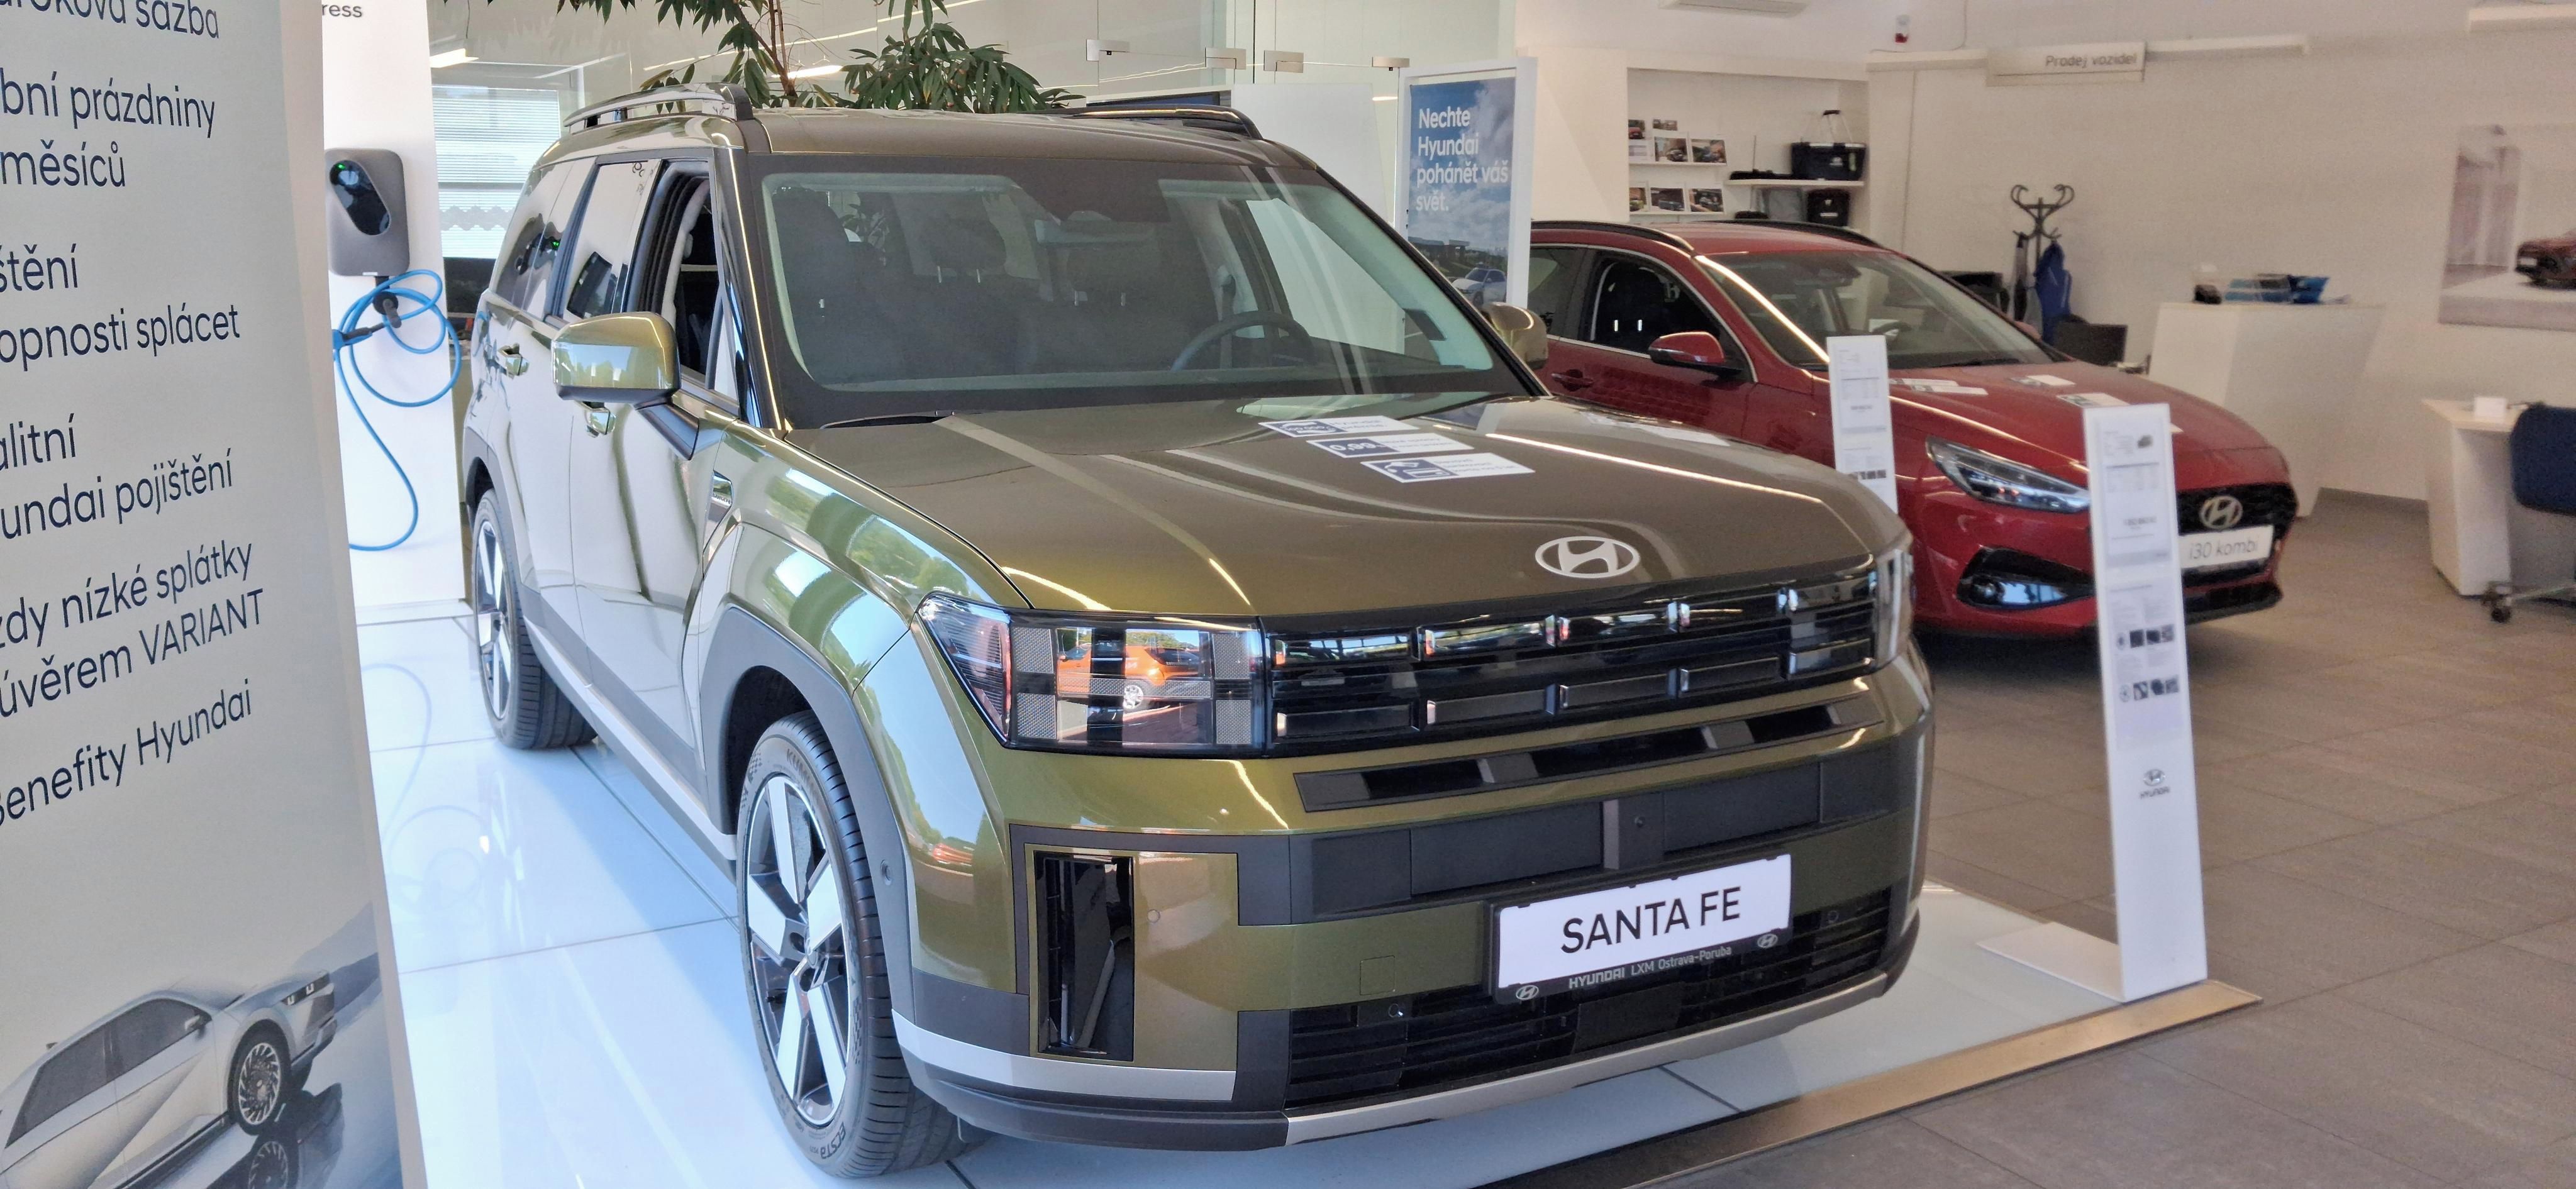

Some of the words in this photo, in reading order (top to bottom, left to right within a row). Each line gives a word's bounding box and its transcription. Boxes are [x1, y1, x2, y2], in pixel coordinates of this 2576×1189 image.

[135, 0, 219, 38] sazba
[2045, 55, 2087, 69] Prodej
[0, 67, 58, 116] bní
[70, 77, 215, 138] prázdniny
[1418, 106, 1471, 129] Nechte
[0, 140, 125, 187] měsíců
[1418, 133, 1479, 160] Hyundai
[1417, 161, 1479, 188] pohánět
[1481, 160, 1509, 184] váš
[1416, 190, 1450, 211] svět.
[0, 308, 128, 372] opnosti
[136, 302, 240, 357] splácet
[1, 476, 105, 539] undai
[116, 448, 232, 524] pojištění
[2189, 541, 2212, 560] i30
[2216, 534, 2259, 556] kombi
[0, 597, 48, 648] dy
[62, 564, 148, 628] nízké
[157, 540, 252, 604] splátky
[0, 655, 132, 717] úvěrem
[138, 589, 264, 665] VARIANT
[136, 678, 252, 765] Hyundai
[1561, 897, 1690, 954] SANTA
[1700, 887, 1741, 926] FE
[1568, 967, 1626, 989] HYUNDAI
[1631, 961, 1655, 976] LXM
[1657, 946, 1732, 970] Ostrava-Poruba
